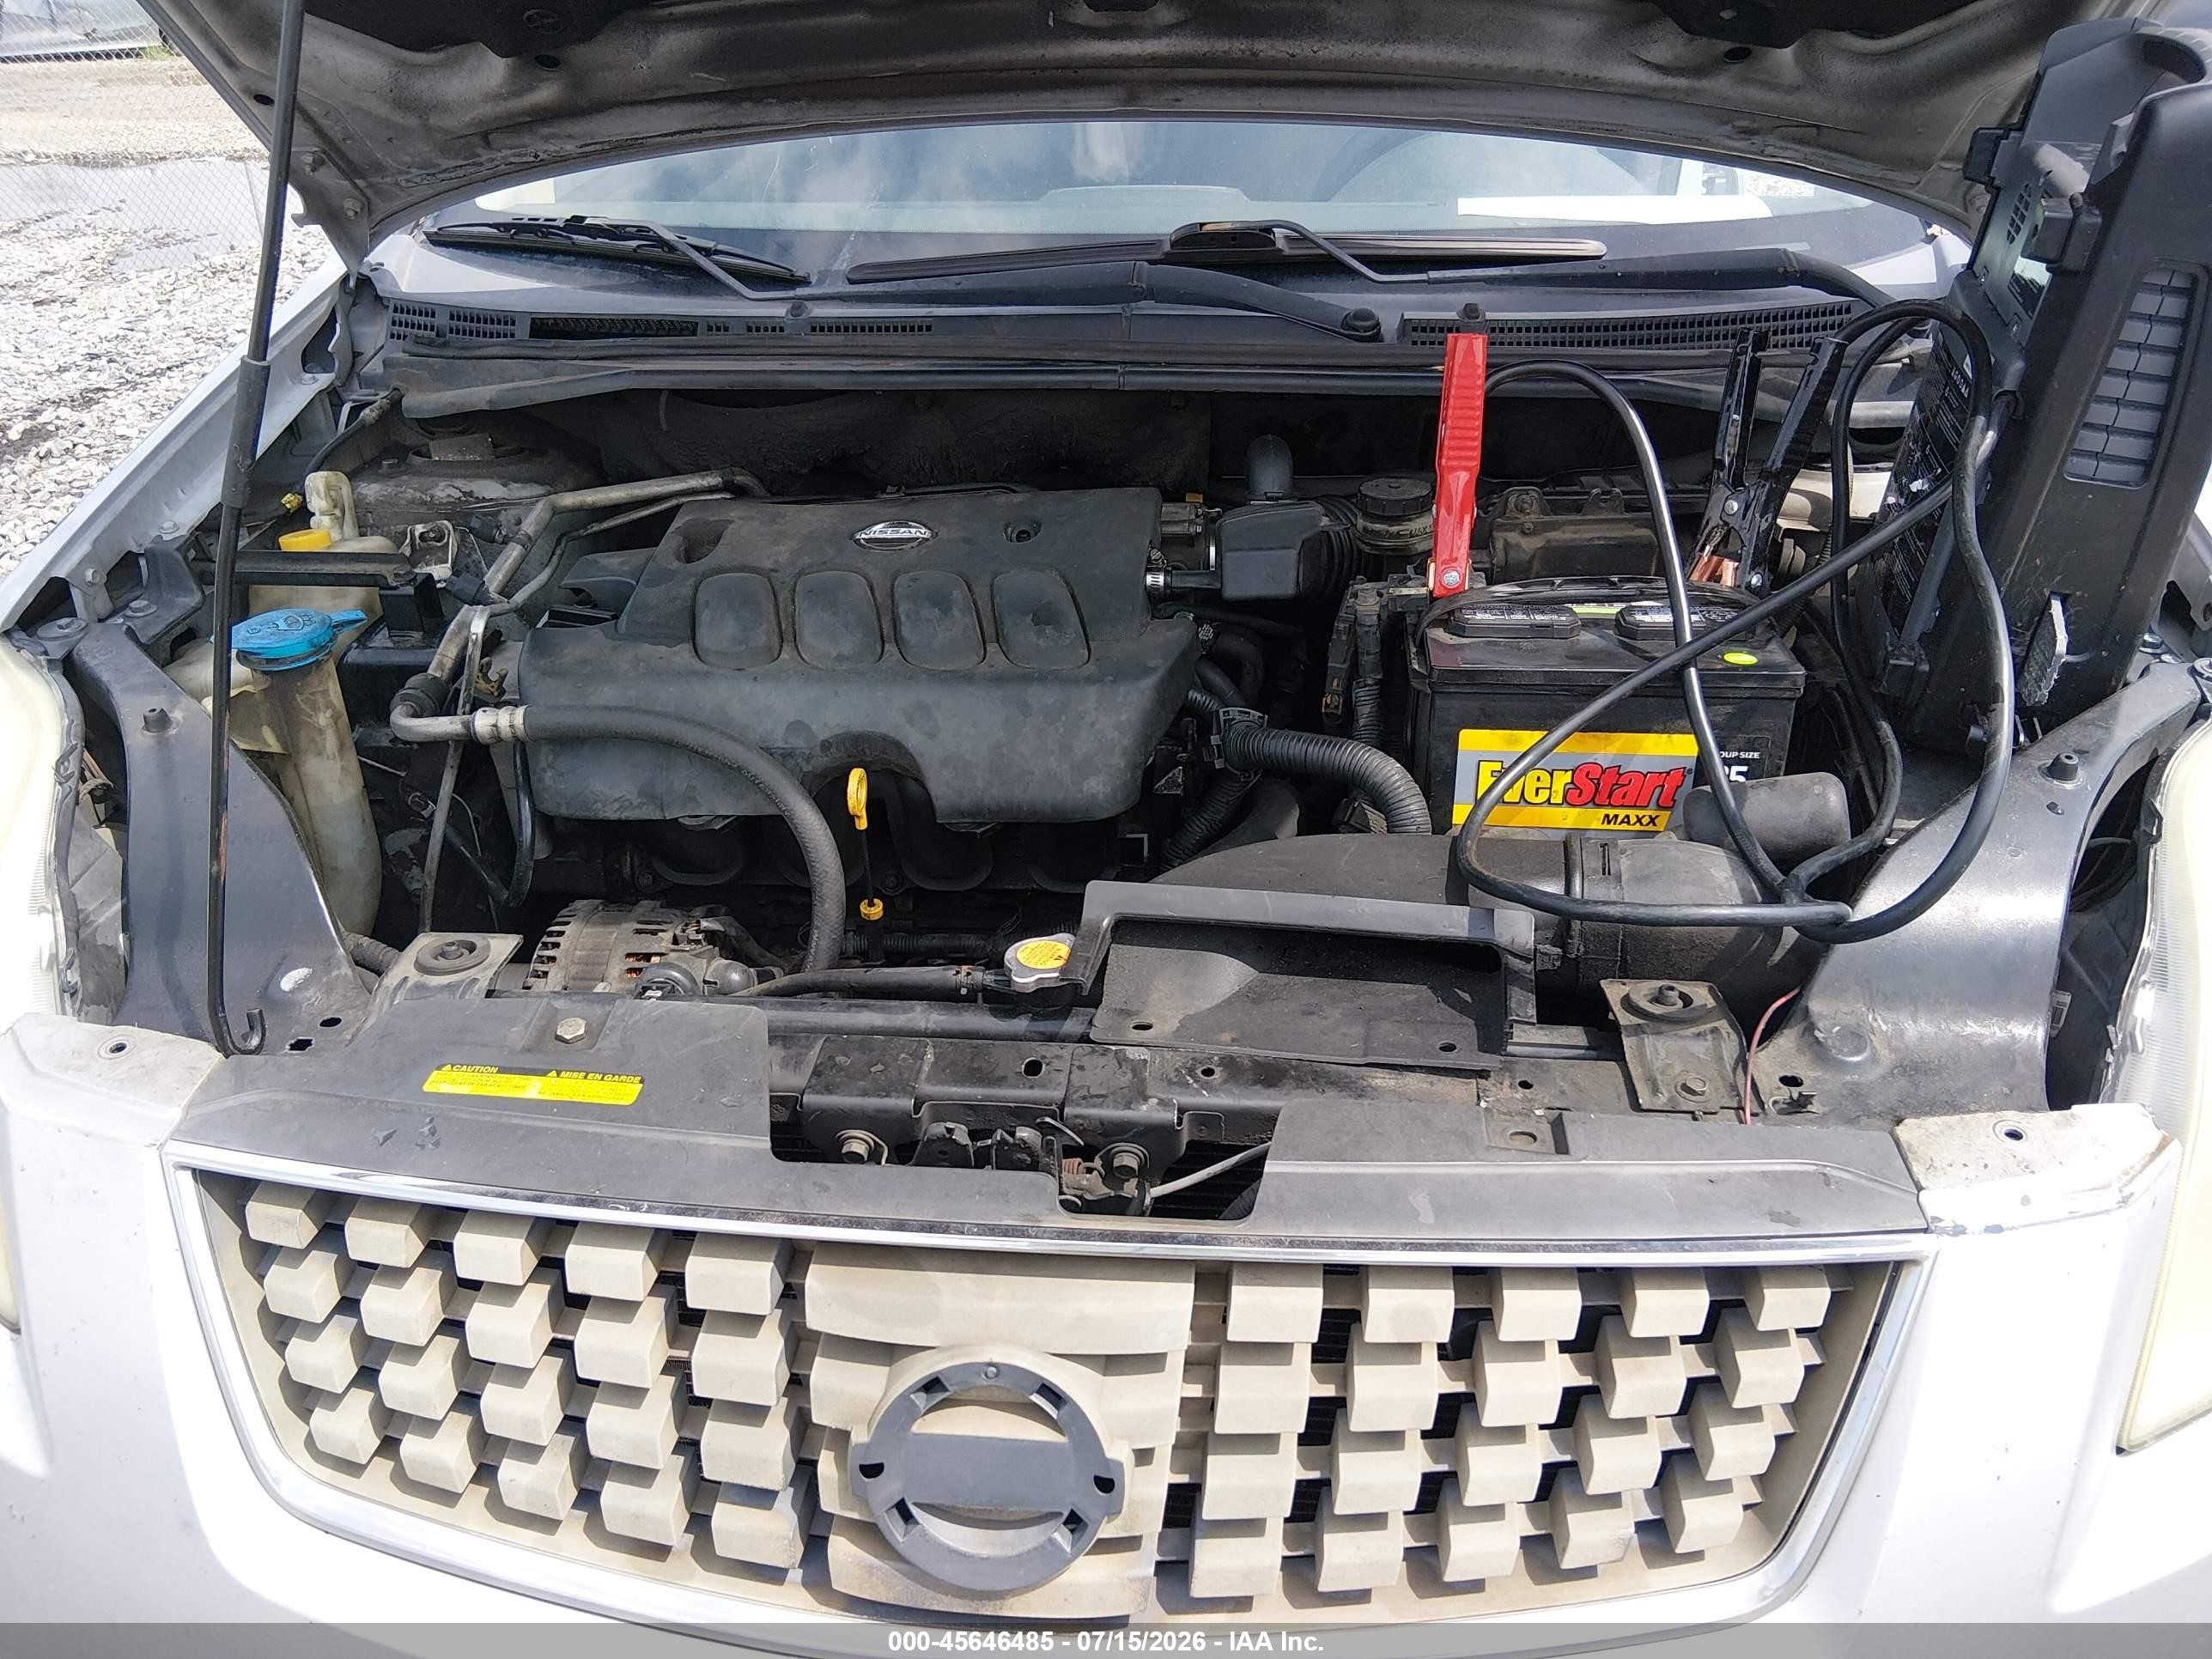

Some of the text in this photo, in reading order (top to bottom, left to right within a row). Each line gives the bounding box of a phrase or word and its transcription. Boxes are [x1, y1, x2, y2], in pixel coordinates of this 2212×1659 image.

[1724, 765, 1748, 782] 5
[1601, 812, 1661, 828] MAXX
[453, 1065, 498, 1073] CAUTION
[560, 1071, 586, 1079] MISE
[604, 1074, 641, 1084] GARDE
